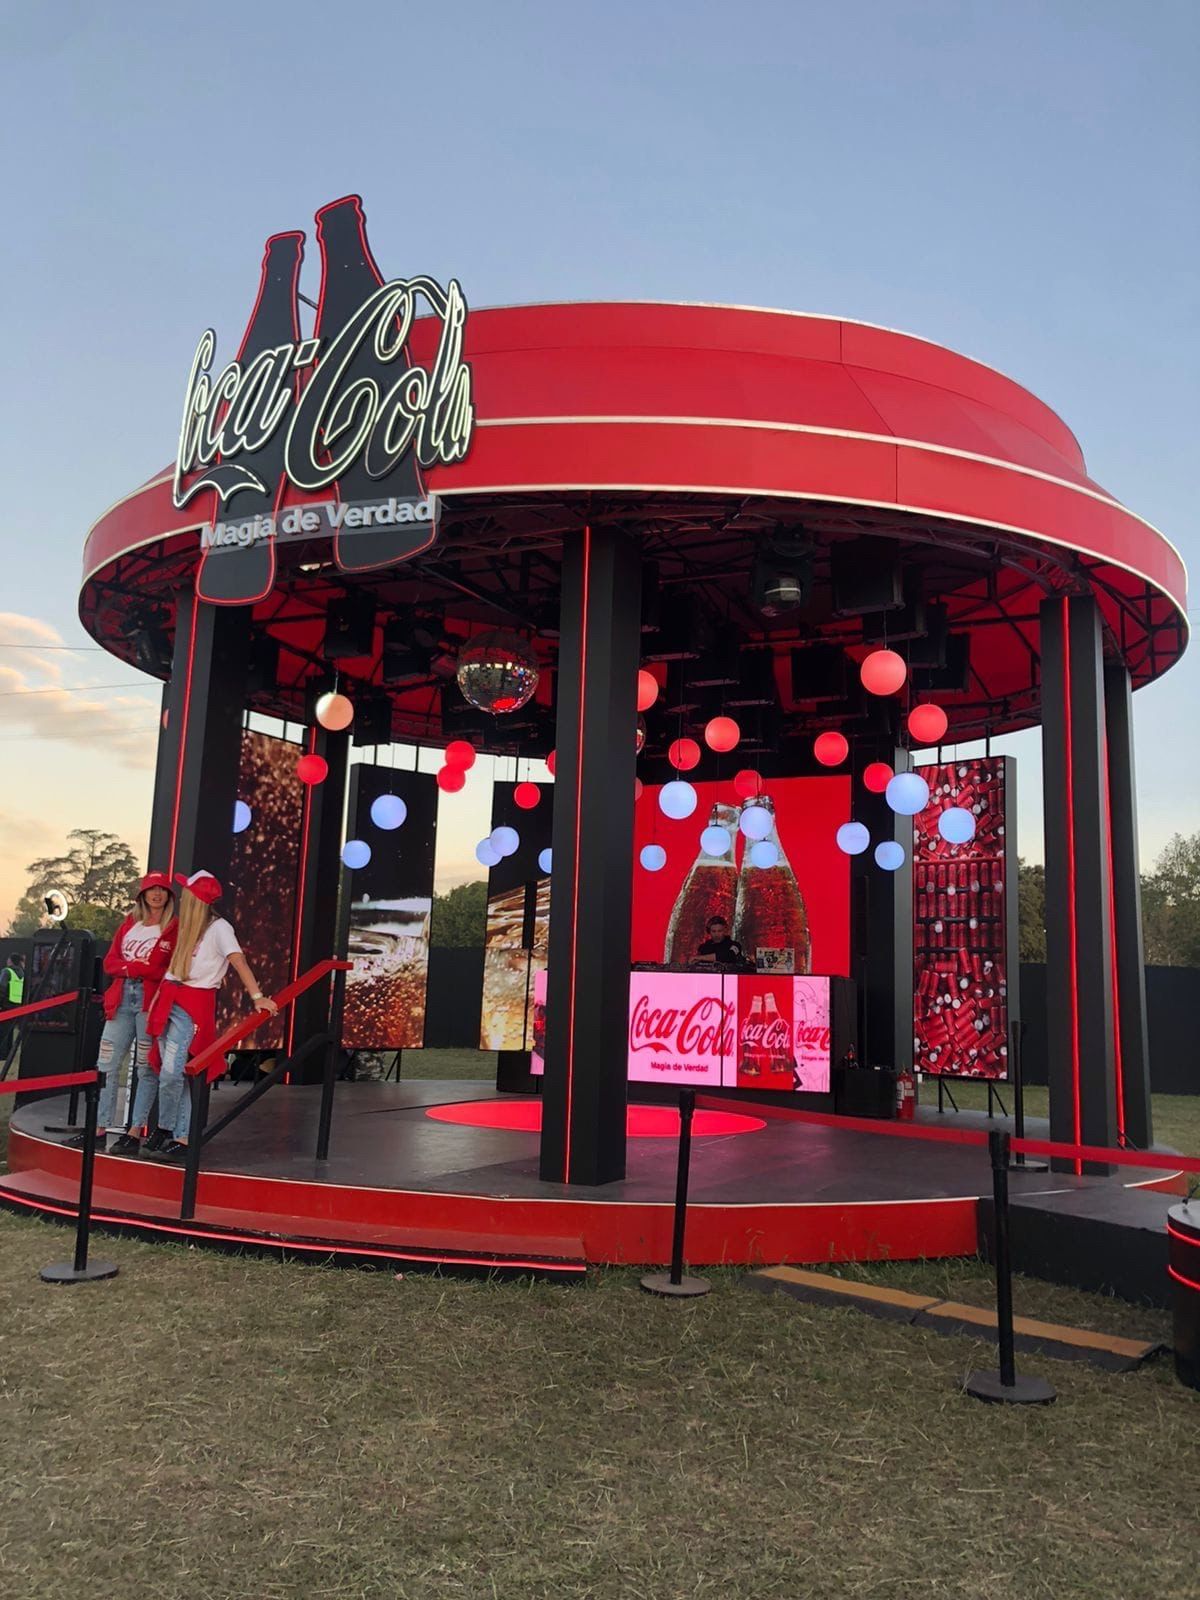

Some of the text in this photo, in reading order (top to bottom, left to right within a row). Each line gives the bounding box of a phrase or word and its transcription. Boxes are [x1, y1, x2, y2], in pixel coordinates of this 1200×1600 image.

[172, 276, 474, 508] Coca-Cola
[200, 493, 437, 549] Magia de Verdad
[630, 995, 735, 1057] Coca-Cola
[650, 1061, 709, 1073] Magia de Verdad
